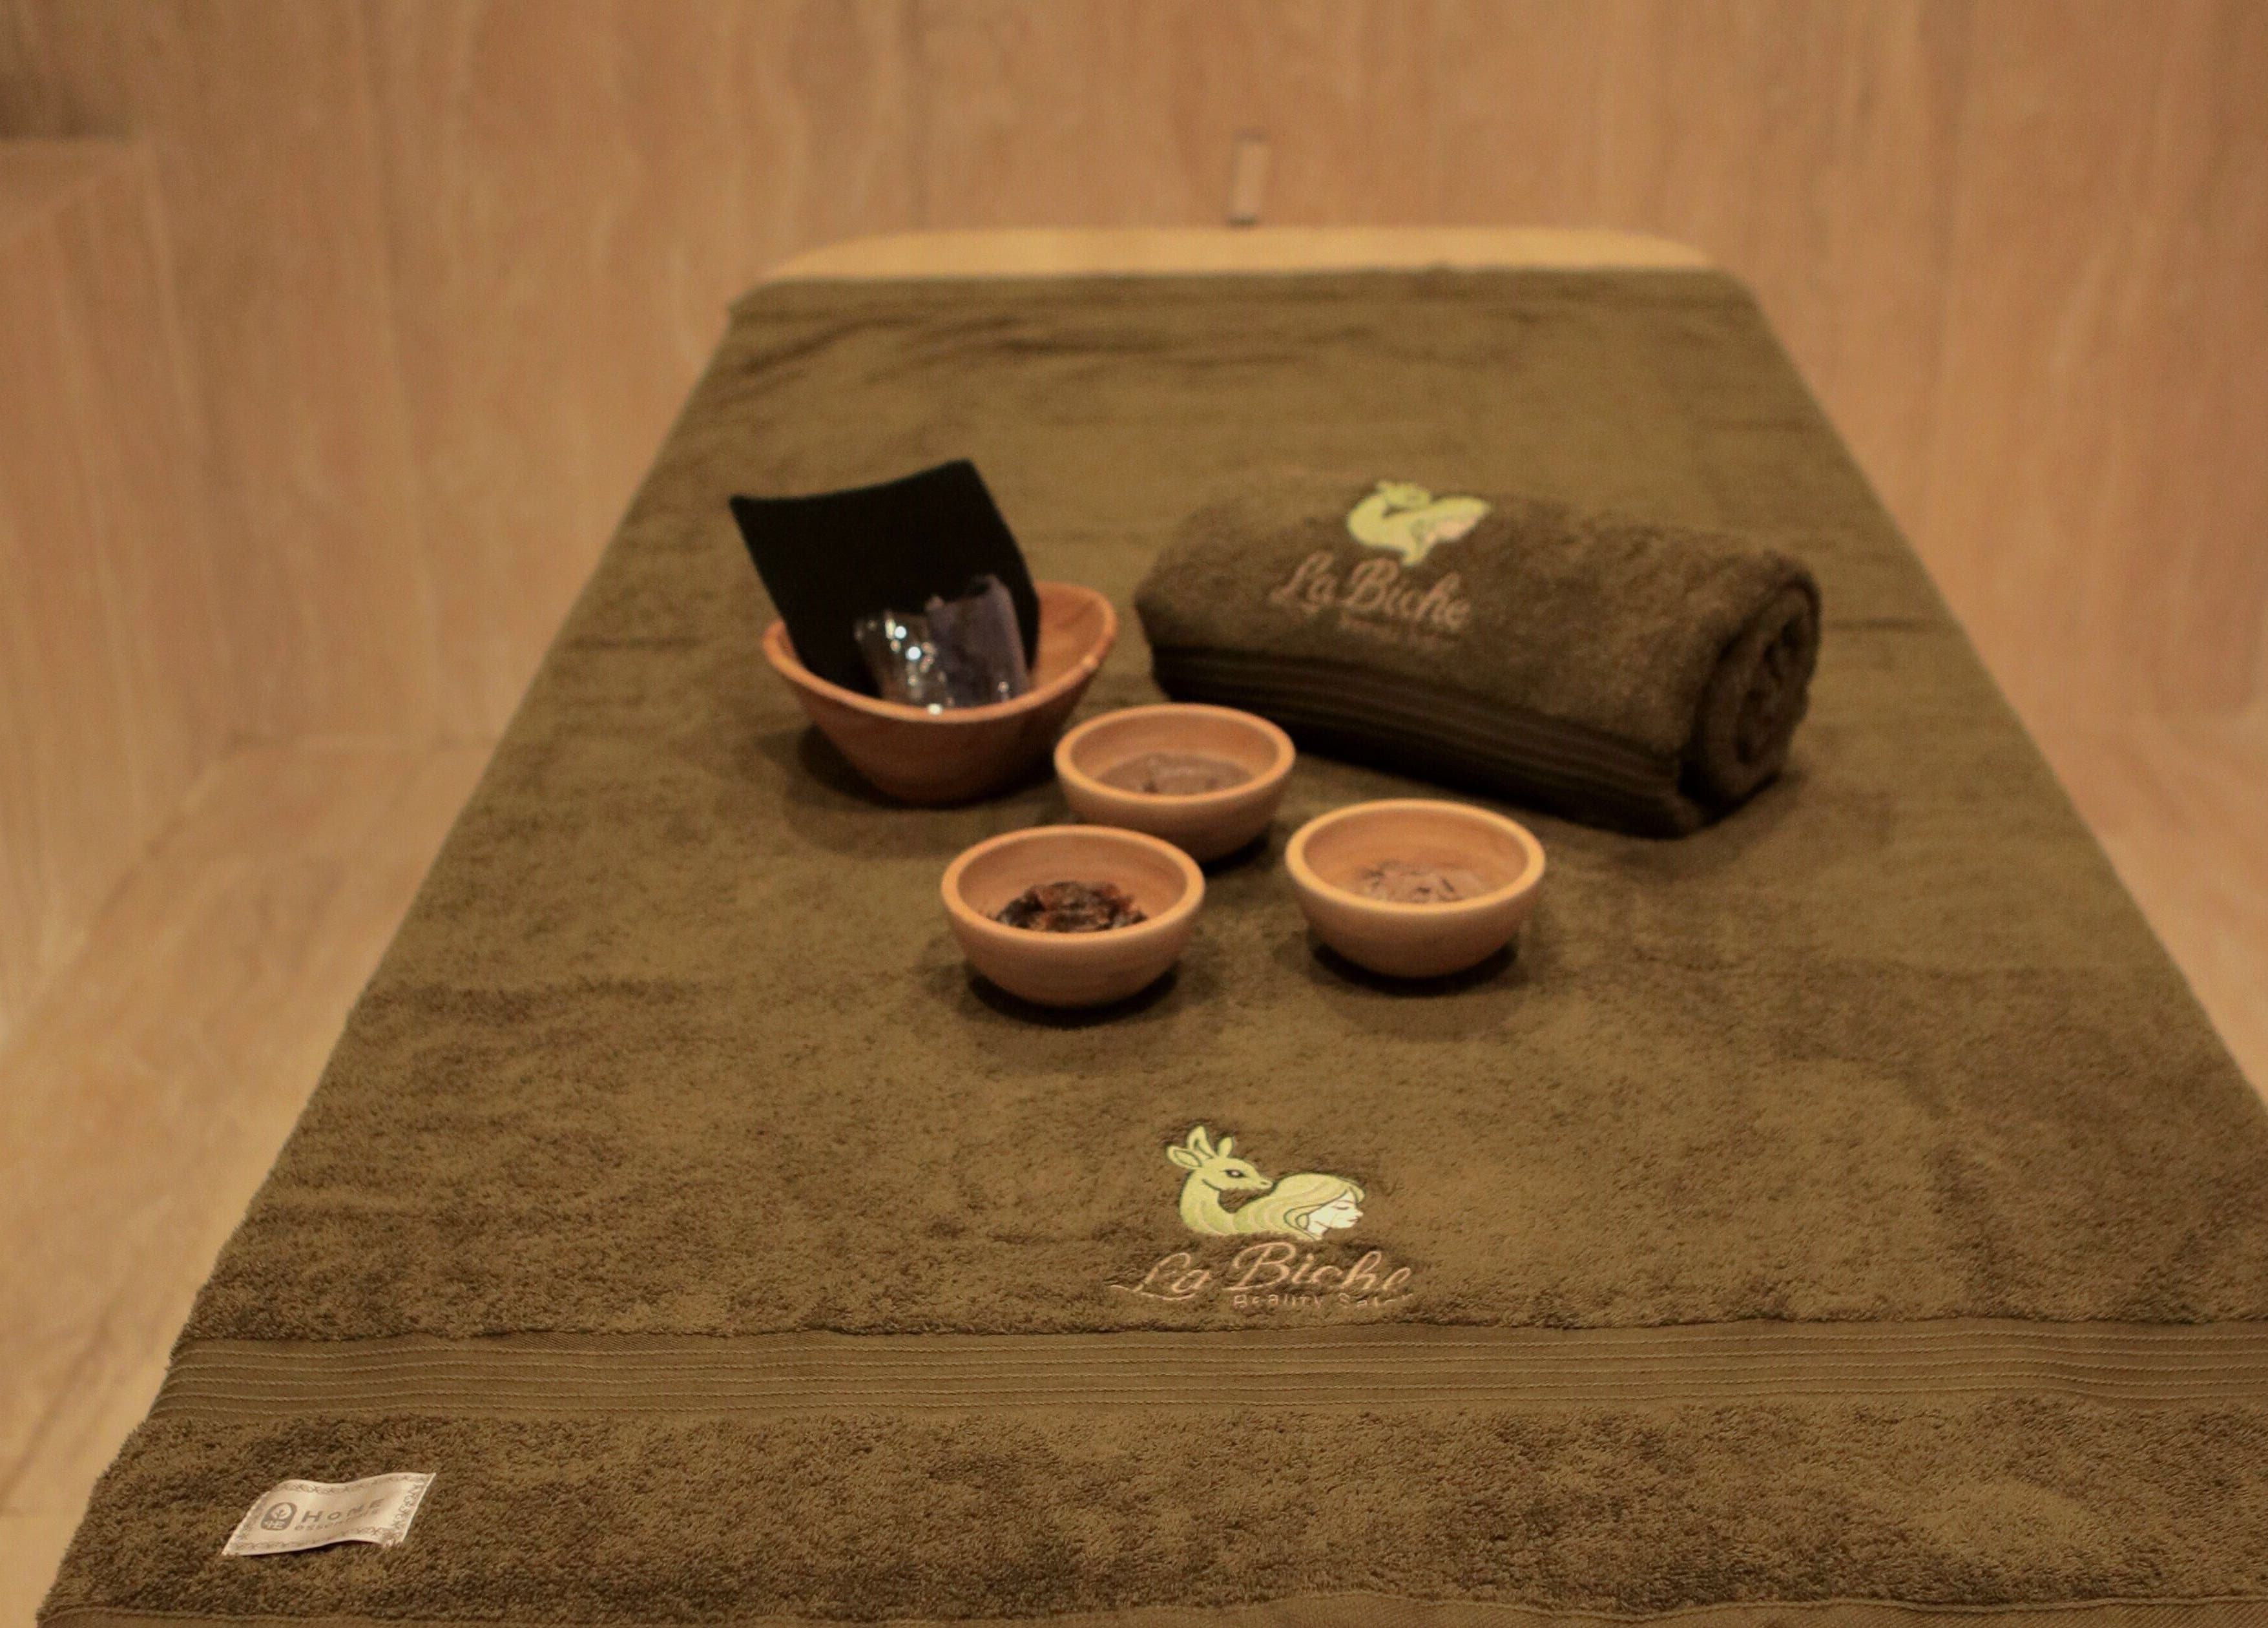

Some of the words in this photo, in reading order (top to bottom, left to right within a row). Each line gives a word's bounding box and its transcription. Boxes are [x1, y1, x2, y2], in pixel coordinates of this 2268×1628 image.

[1269, 550, 1337, 615] La
[1110, 1252, 1212, 1301] La
[1223, 1241, 1411, 1292] Biche
